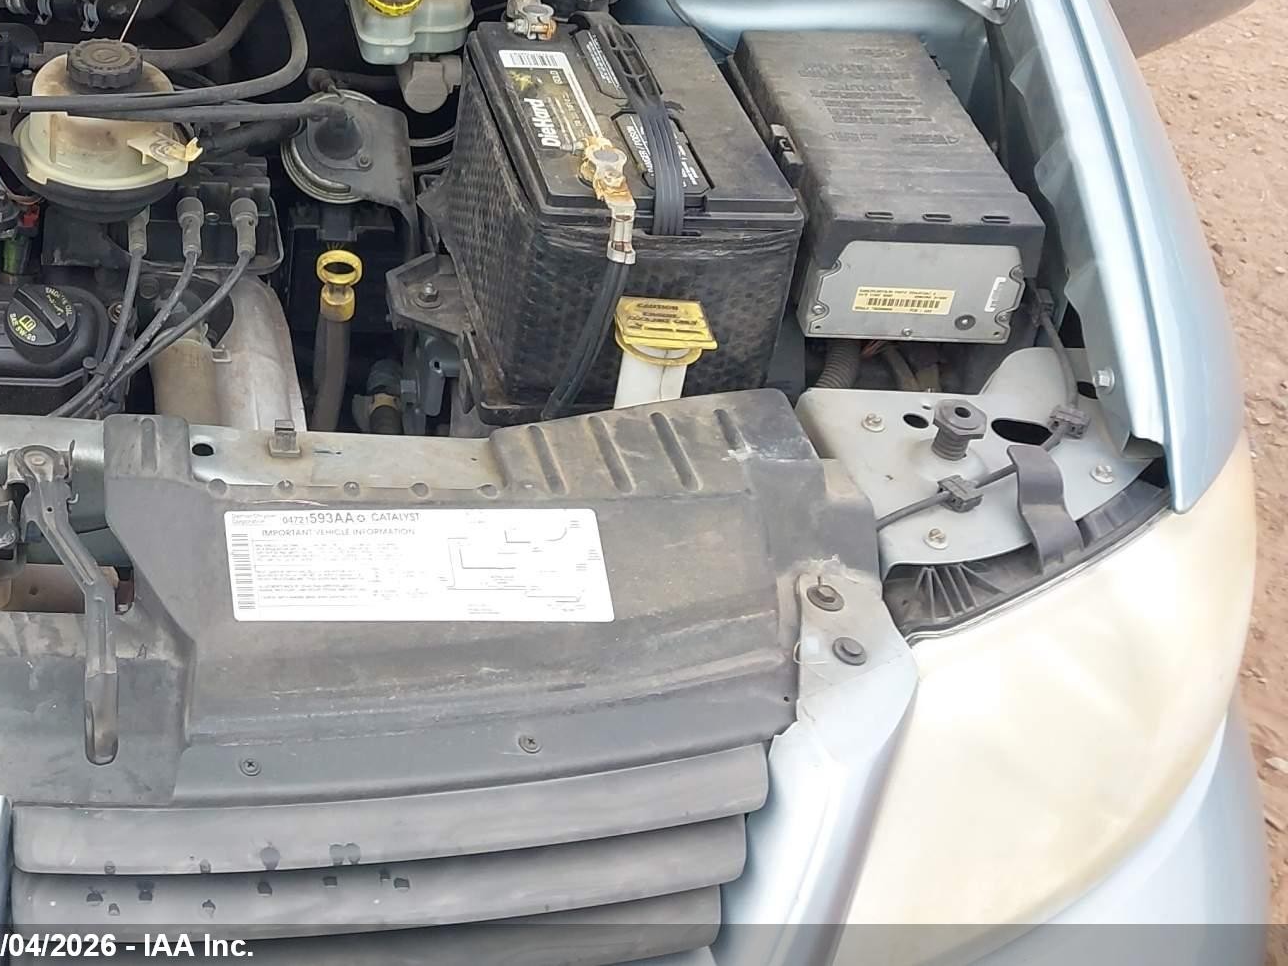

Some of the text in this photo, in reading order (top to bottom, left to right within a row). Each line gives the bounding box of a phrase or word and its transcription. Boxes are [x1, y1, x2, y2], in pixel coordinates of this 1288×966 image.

[524, 97, 561, 147] DieHard
[15, 325, 36, 342] 5W-20
[282, 512, 354, 524] 04721593AA
[371, 512, 420, 522] CATALYST
[262, 529, 312, 537] IMPORTANT
[315, 528, 350, 536] VEHICLE
